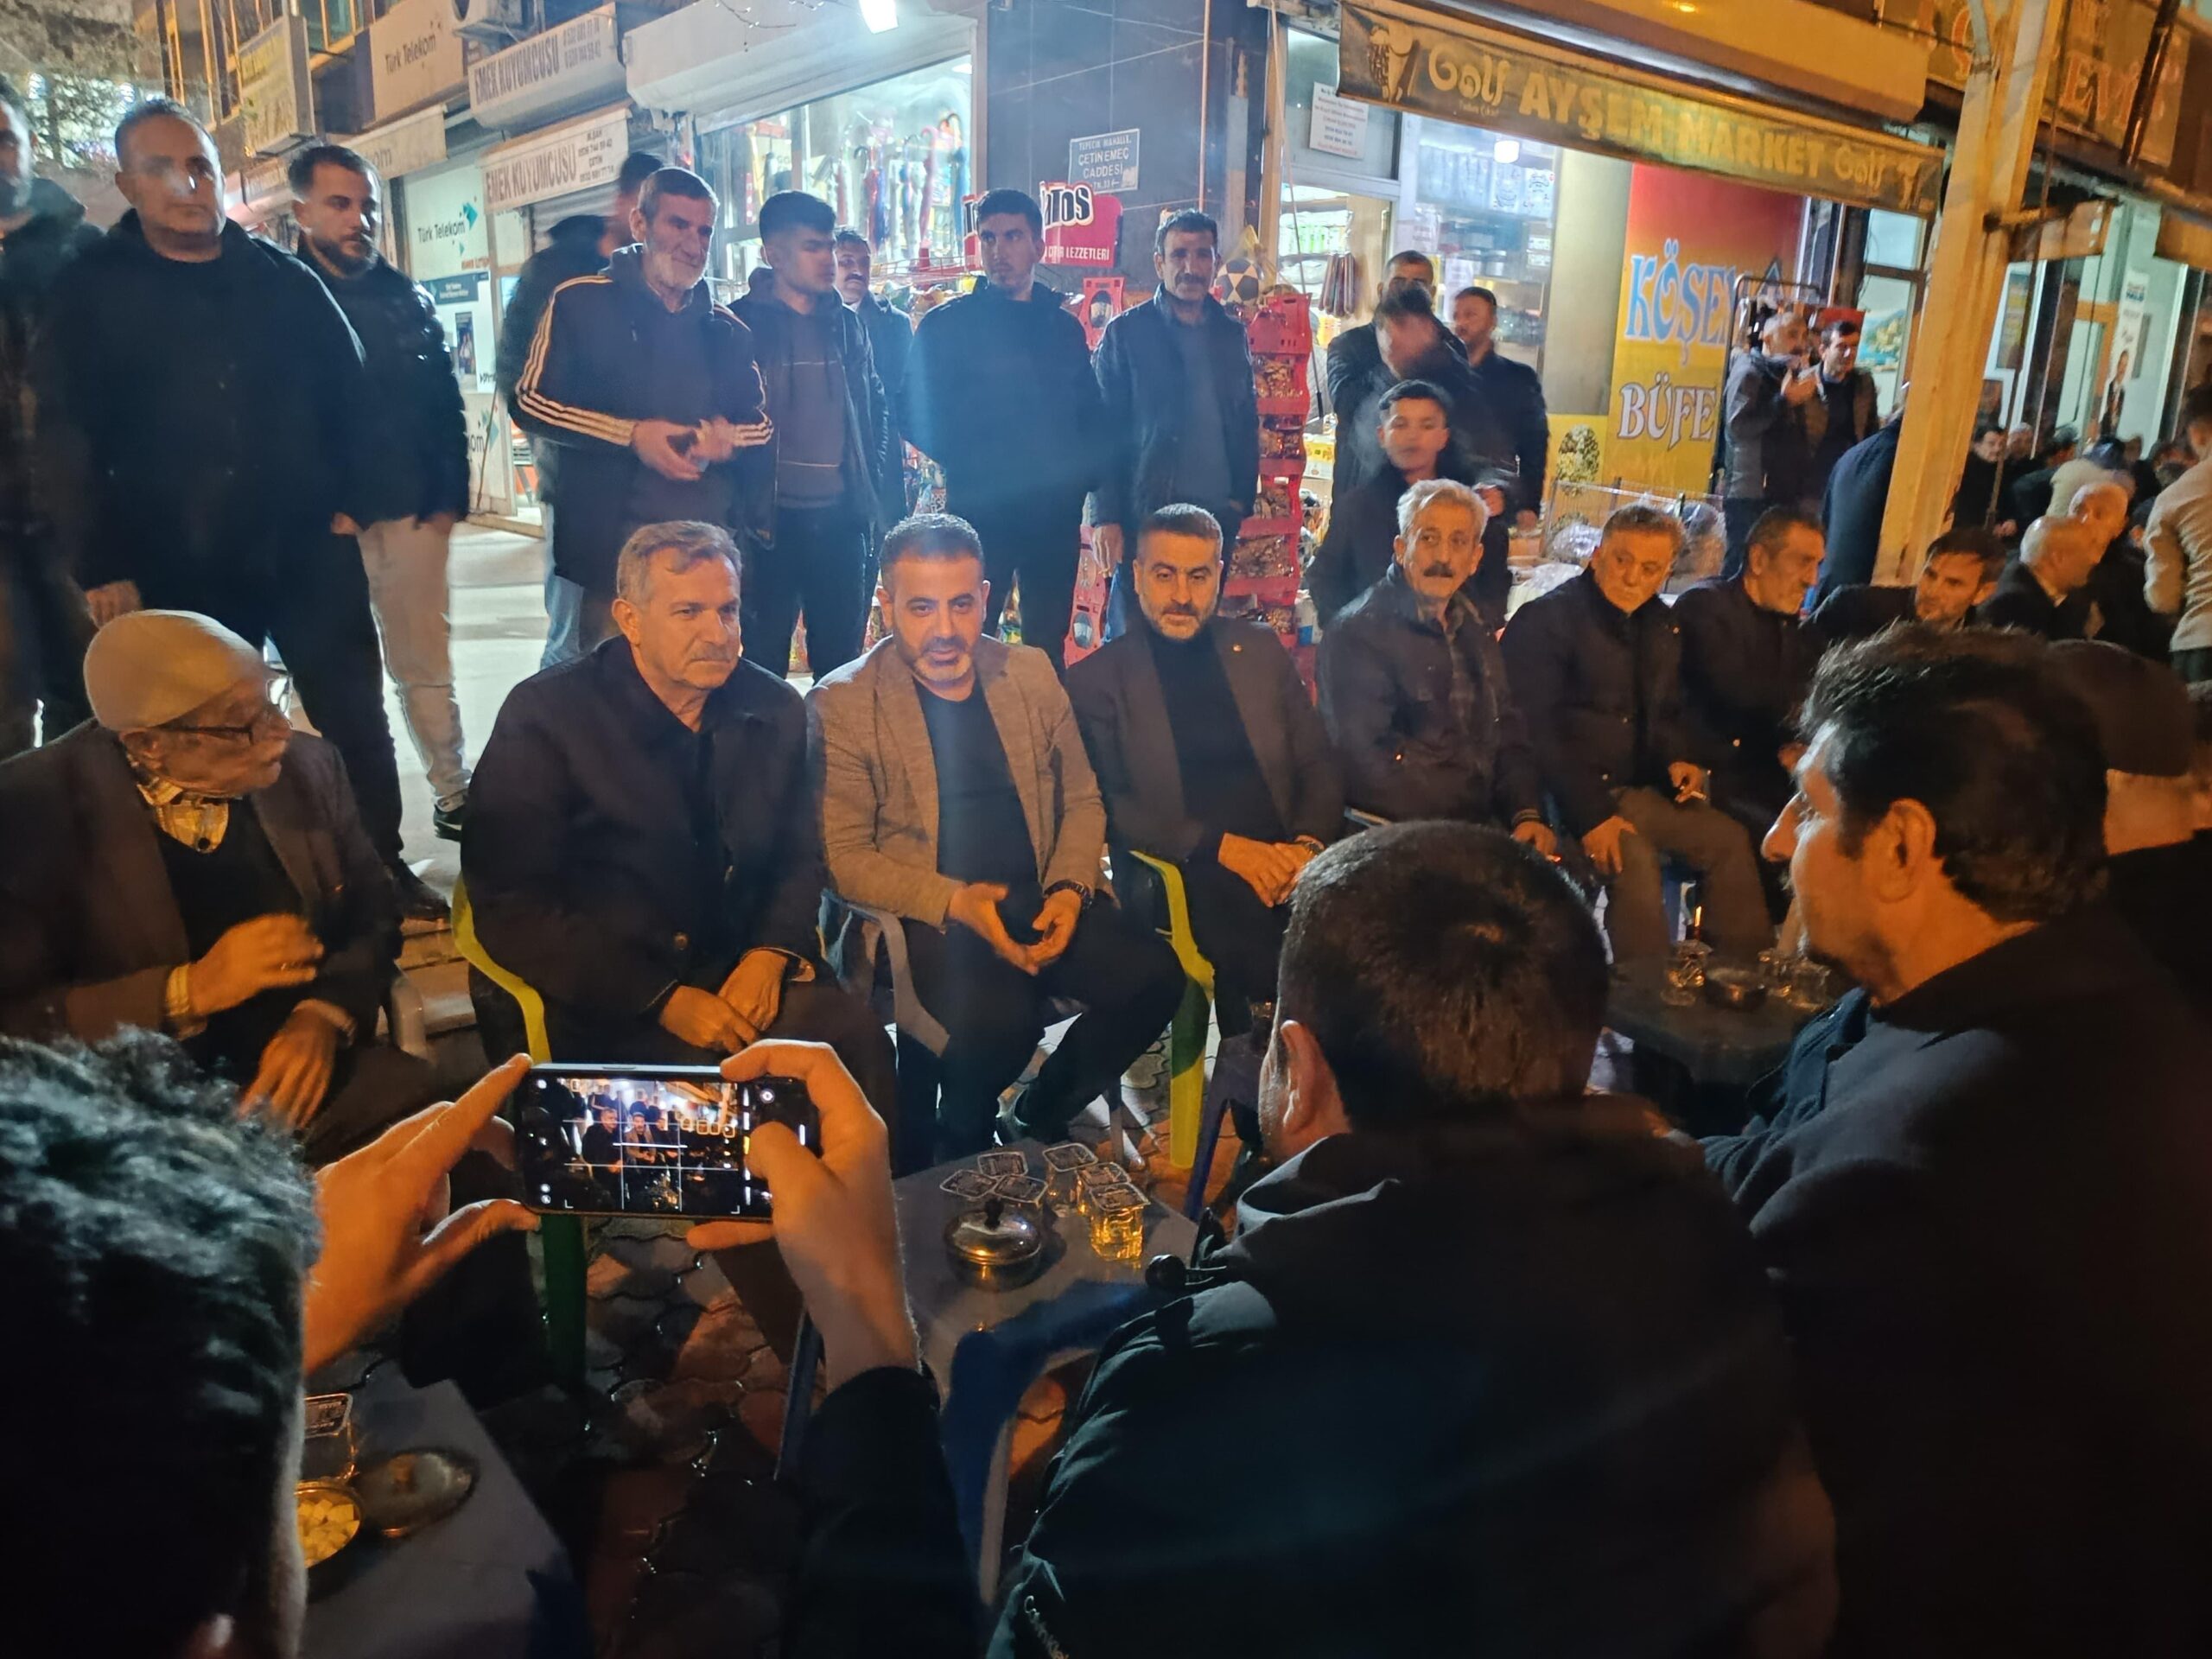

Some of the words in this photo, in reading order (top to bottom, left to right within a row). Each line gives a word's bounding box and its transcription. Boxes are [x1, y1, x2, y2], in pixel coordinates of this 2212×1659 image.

[385, 48, 402, 75] Türk
[402, 34, 436, 66] Telekom
[474, 58, 499, 105] EMEK
[499, 34, 560, 96] KUYUMCUSU
[1428, 42, 1510, 107] Golf
[1519, 72, 1663, 147] AYŞEM
[1678, 112, 1826, 179] MARKET
[486, 164, 512, 205] EMEK
[512, 143, 577, 199] KUYUMCUSU
[1077, 150, 1104, 166] ÇETİN
[417, 226, 433, 244] Türk
[434, 219, 466, 239] Telekom
[1065, 245, 1110, 261] LEZZETLERİ
[1618, 372, 1718, 452] BÜFE
